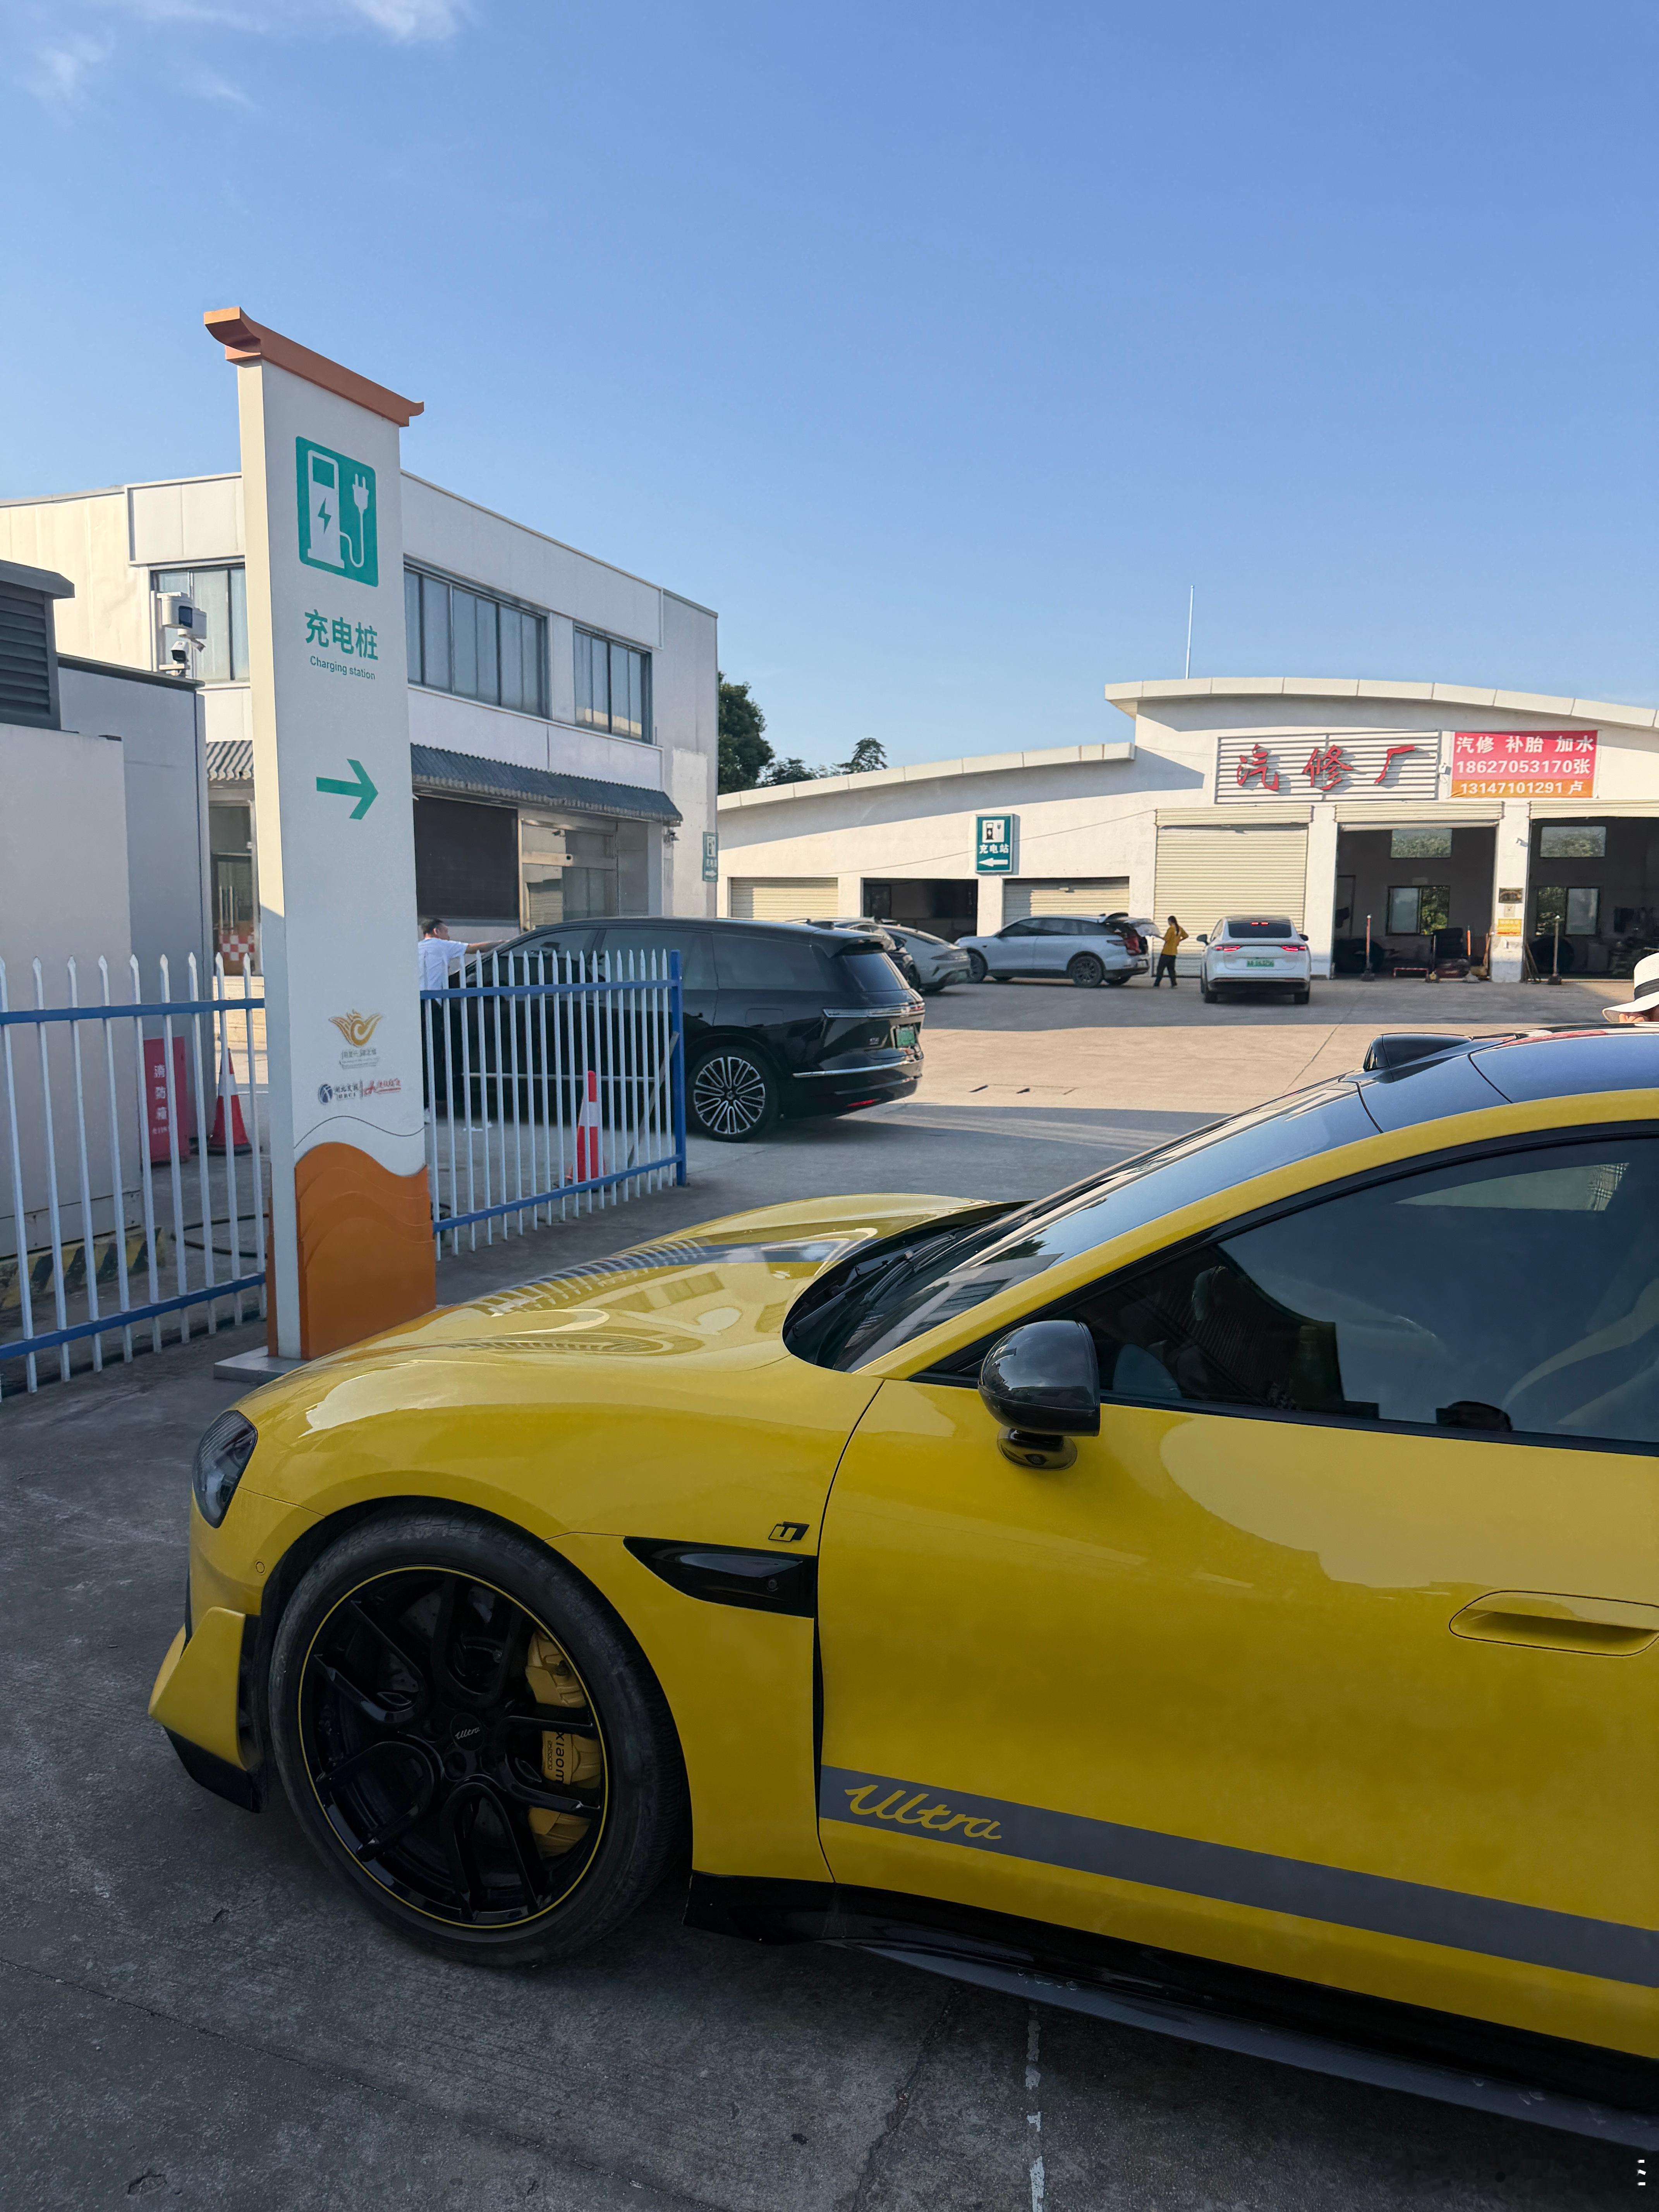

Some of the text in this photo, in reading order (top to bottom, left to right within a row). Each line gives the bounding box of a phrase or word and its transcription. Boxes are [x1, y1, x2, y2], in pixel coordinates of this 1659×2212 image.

[305, 609, 378, 660] 充电桩
[310, 655, 376, 680] Charging station
[1456, 735, 1594, 753] 汽修 补胎 加水
[1237, 744, 1415, 791] 汽修厂
[1456, 758, 1590, 775] 18627053170张
[1461, 780, 1583, 795] 13147101291 卢
[979, 843, 1010, 854] 充电站
[455, 1727, 481, 1739] Ultra
[555, 1731, 565, 1782] xiaom
[844, 1784, 1002, 1840] Ultra
